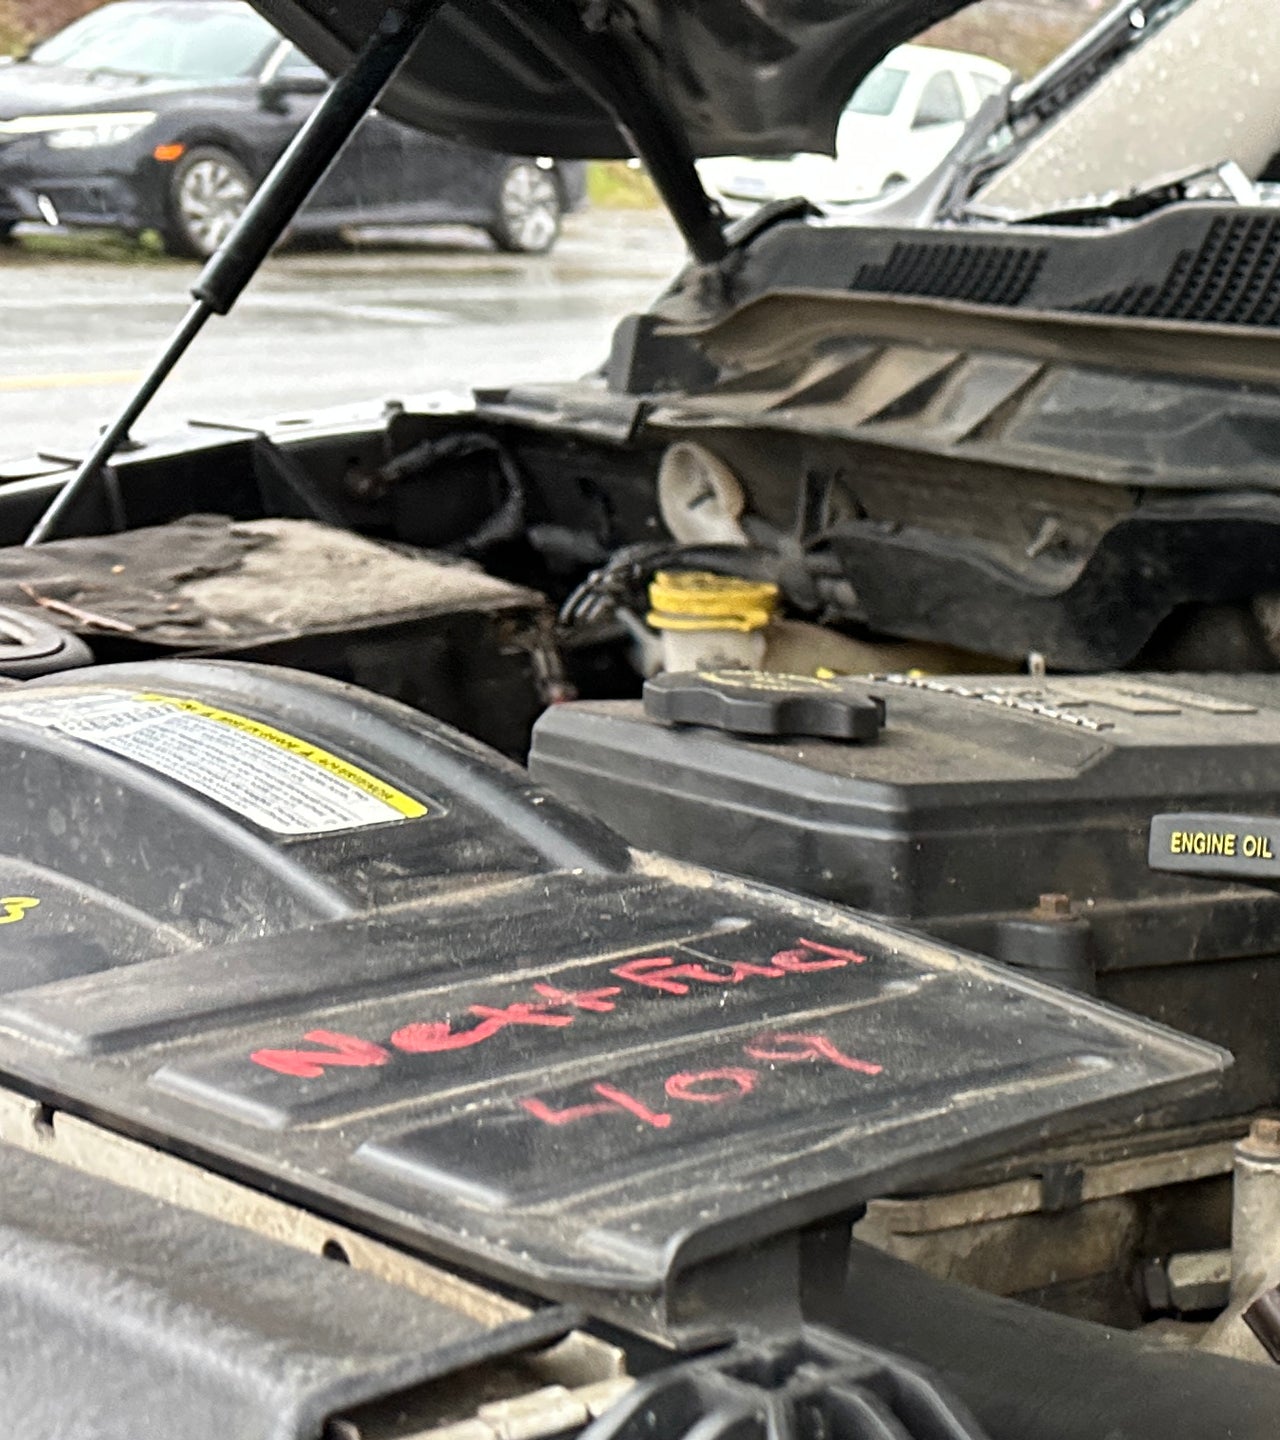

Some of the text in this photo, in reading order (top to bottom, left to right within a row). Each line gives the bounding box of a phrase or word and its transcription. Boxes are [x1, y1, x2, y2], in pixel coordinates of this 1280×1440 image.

[1171, 831, 1274, 859] ENGINE OIL
[520, 1030, 884, 1129] 409
